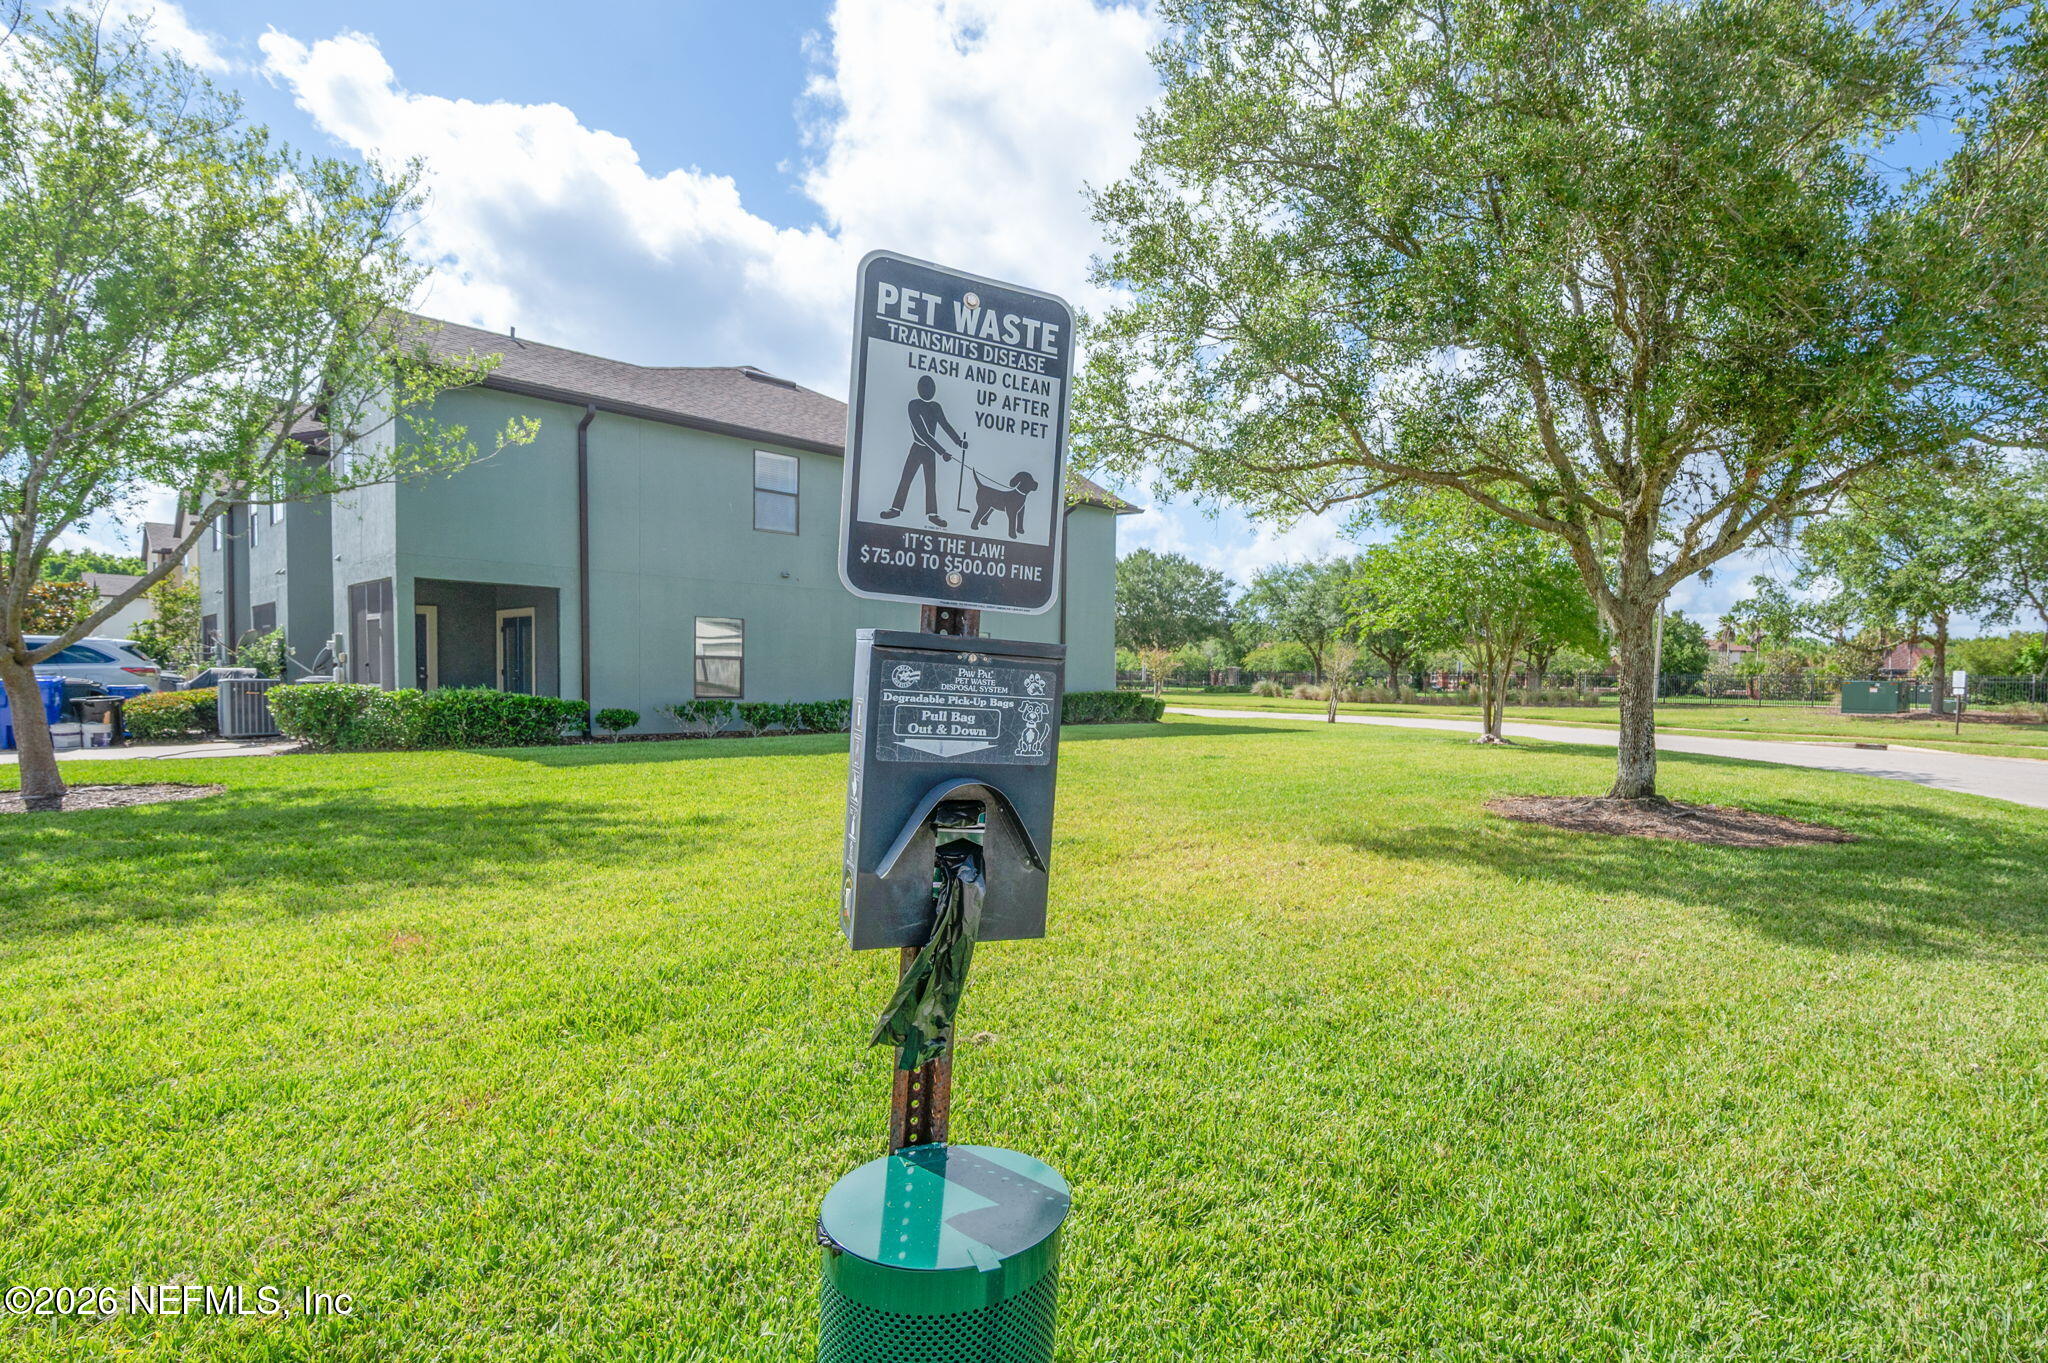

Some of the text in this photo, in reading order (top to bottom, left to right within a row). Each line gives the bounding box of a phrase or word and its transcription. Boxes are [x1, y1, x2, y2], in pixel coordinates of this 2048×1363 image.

[876, 281, 1059, 355] PET WASTE
[888, 322, 1046, 374] TRANSMITS DISEASE
[908, 352, 1051, 397] LEASH AND CLEAN
[976, 389, 1050, 419] UP AFTER
[974, 411, 1049, 440] YOUR PET
[903, 532, 1005, 560] IT'S THE LAW!
[860, 544, 1043, 583] $75.00 TO $500.00 FINE
[955, 677, 996, 686] PET WASTE
[958, 667, 976, 678] PAW
[882, 692, 1015, 709] Degradable Pick-Up Bags
[941, 683, 1009, 694] DISPOSAL SYSTEM
[907, 723, 987, 736] Out & Down
[921, 710, 976, 725] Pull Bag
